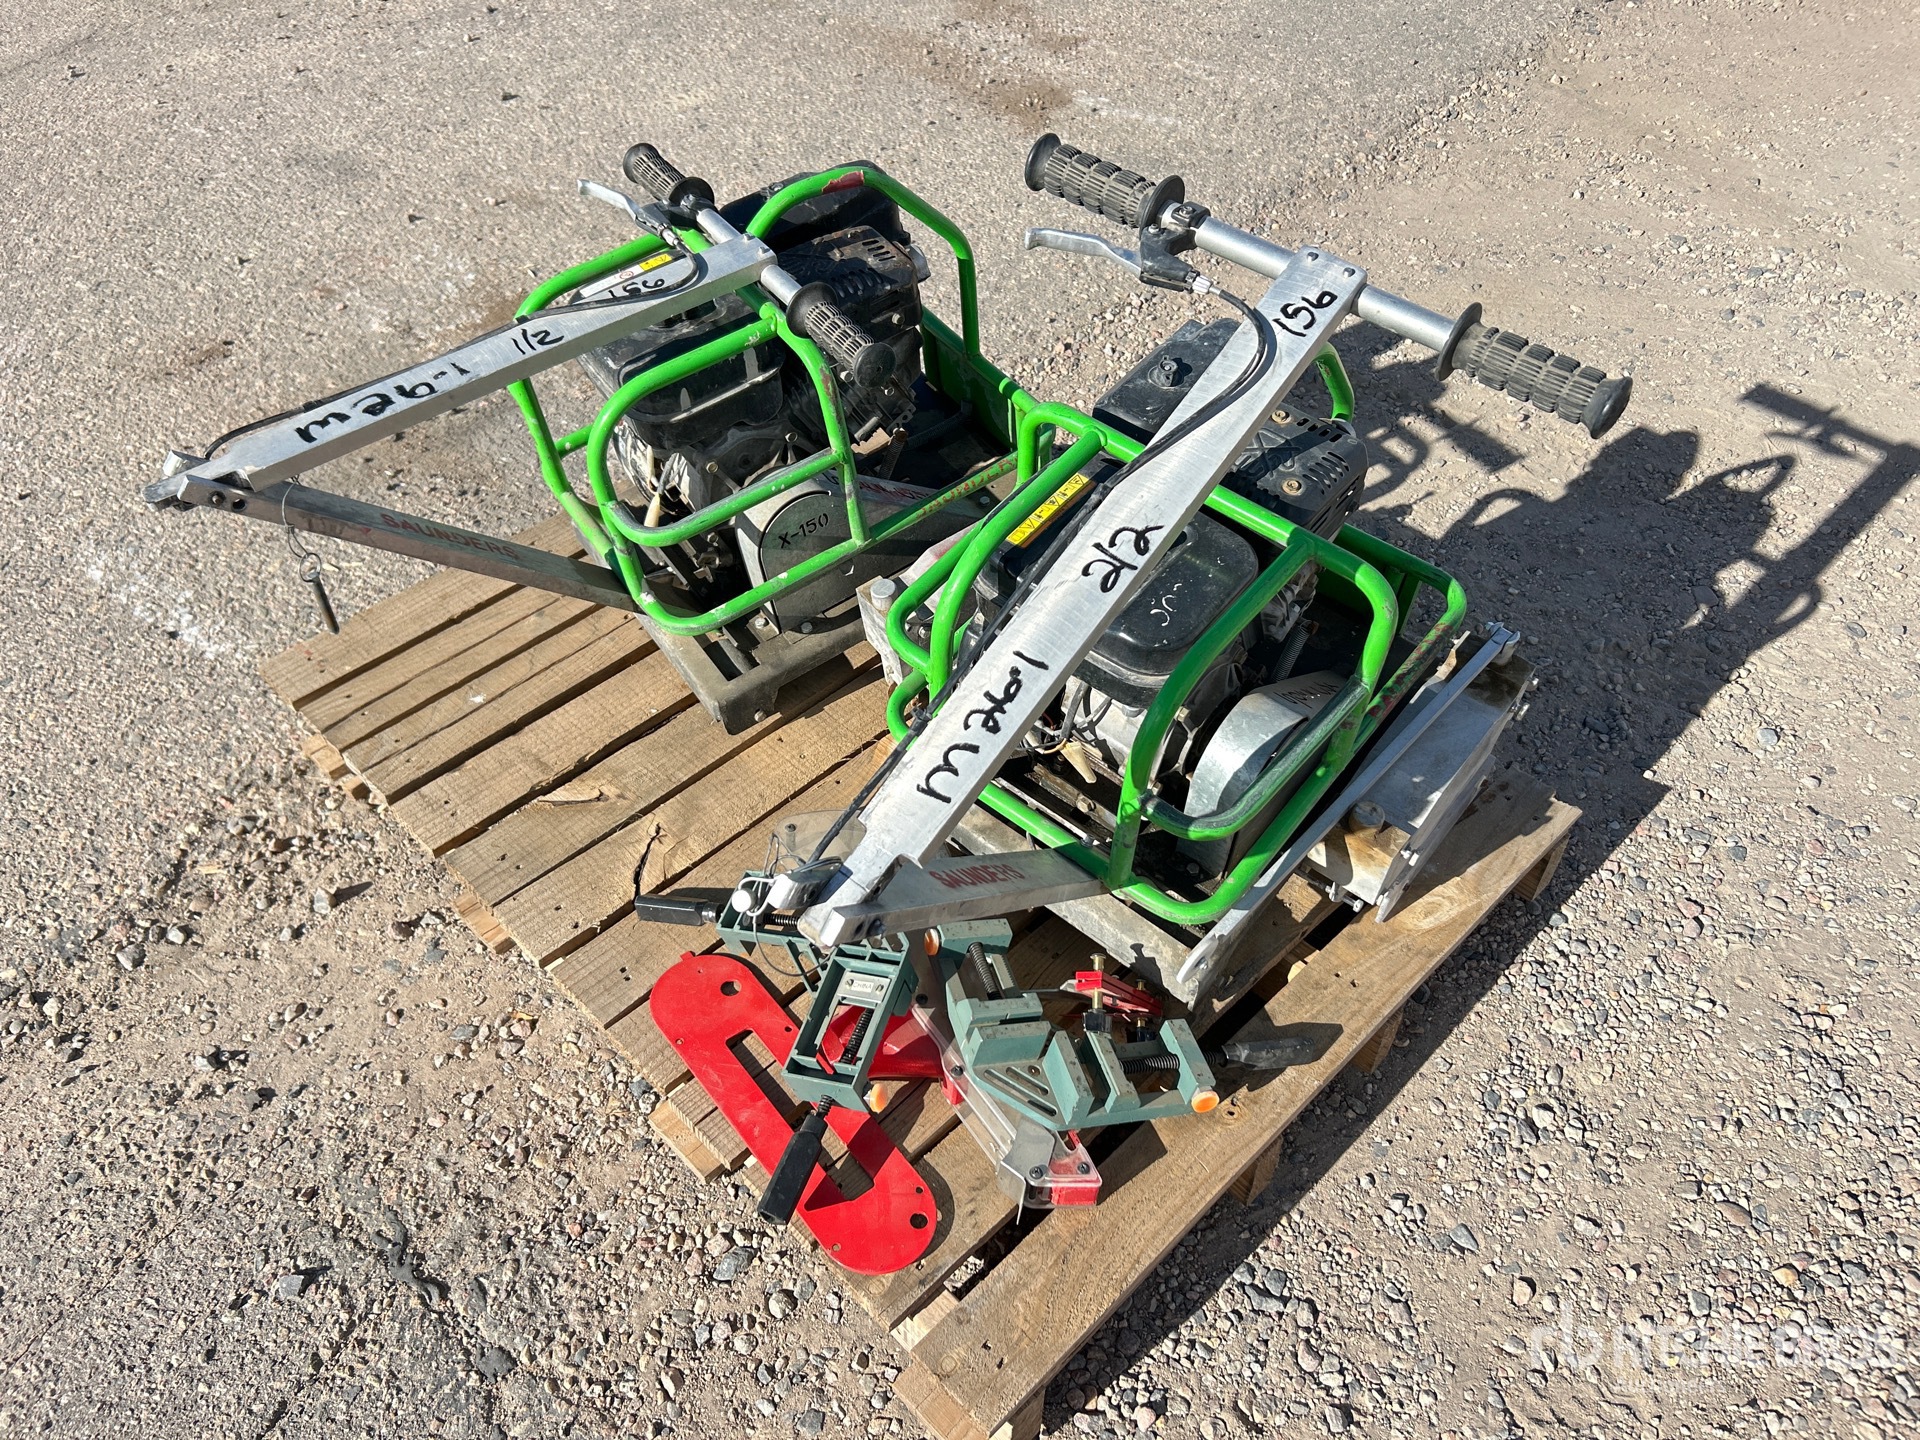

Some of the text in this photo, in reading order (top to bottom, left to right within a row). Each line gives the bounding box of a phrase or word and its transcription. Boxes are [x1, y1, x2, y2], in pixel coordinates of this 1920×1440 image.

[1272, 290, 1339, 337] 156
[512, 328, 565, 355] 1/2
[380, 512, 521, 560] SAUNDERS
[778, 512, 829, 549] X-150
[1081, 525, 1165, 593] 2/2
[928, 863, 1026, 889] SAUNDERS
